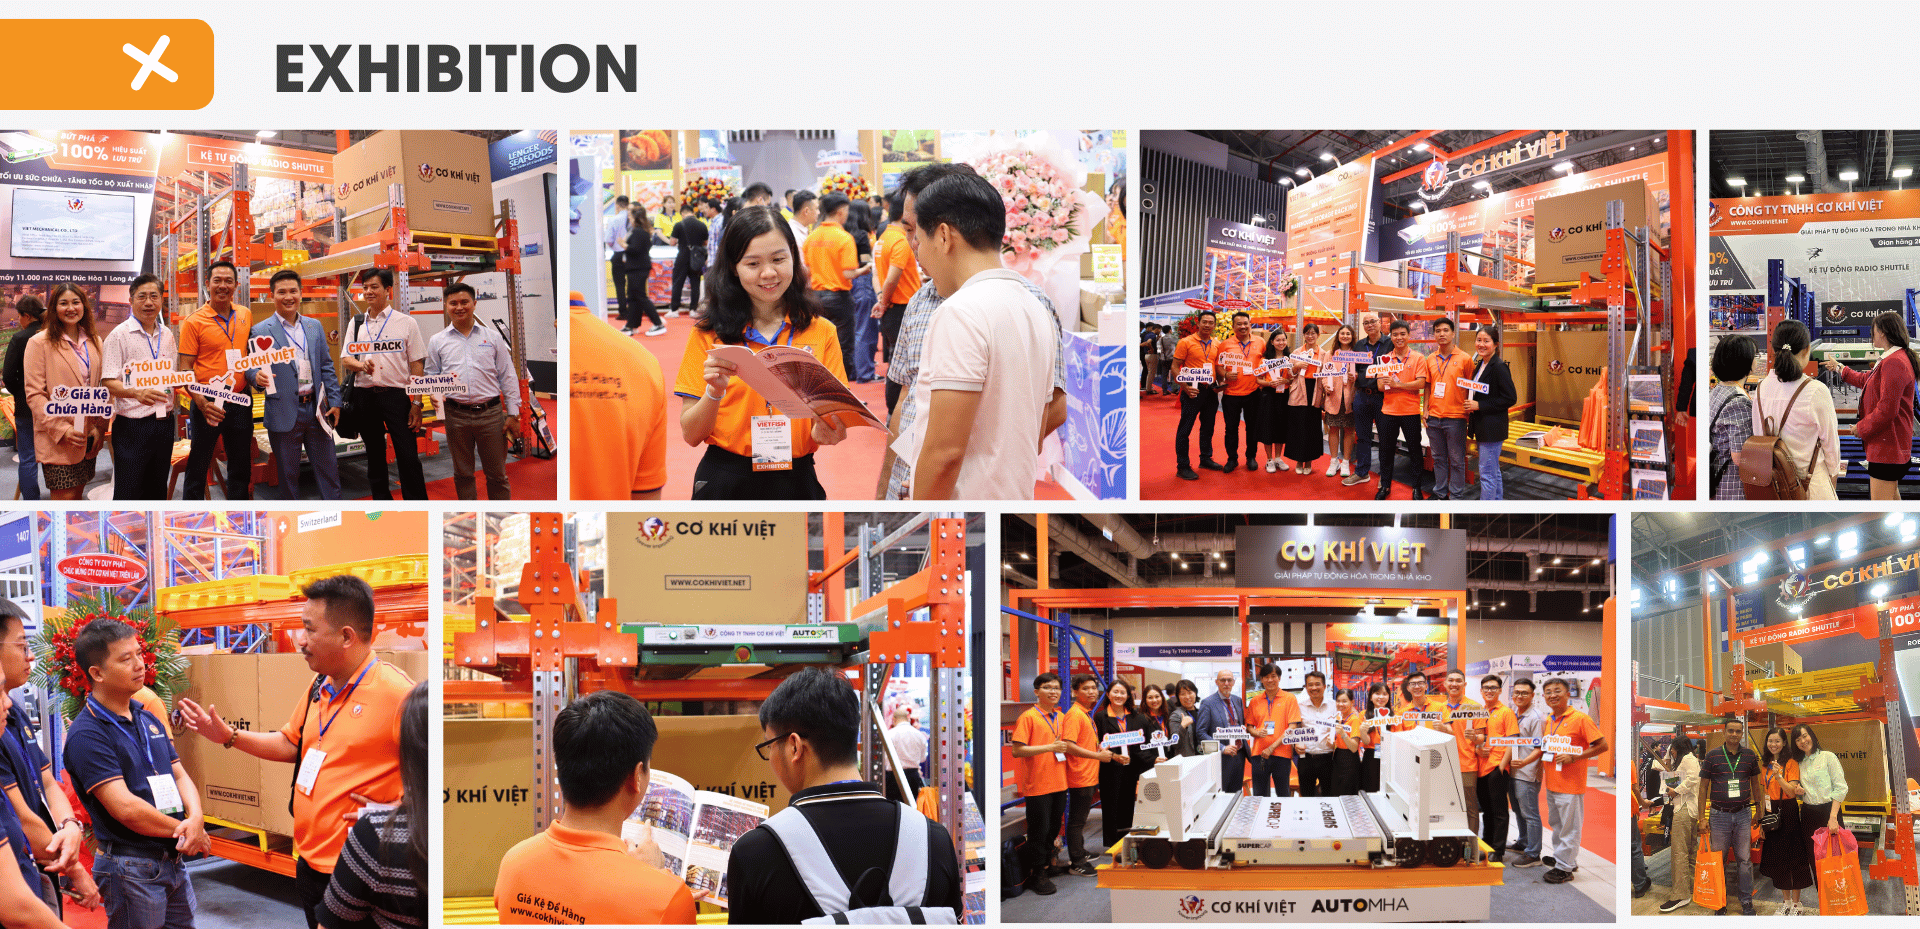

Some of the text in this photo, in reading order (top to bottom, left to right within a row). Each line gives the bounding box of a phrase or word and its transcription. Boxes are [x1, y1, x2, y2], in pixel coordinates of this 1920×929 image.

[61, 142, 109, 161] 100%
[508, 143, 539, 160] LENGER
[509, 146, 554, 168] SEAFOODS
[1458, 130, 1570, 181] CƠ KHÍ VIỆT
[200, 149, 325, 174] KỆ TỰ SHUTTLE
[25, 173, 135, 188] SỨC CHỨA TĂNG TỐC ĐỘ XUẤT
[352, 165, 397, 192] CƠ KHÍ VIỆT
[435, 167, 481, 185] CƠ KHÍ VIỆT
[1334, 202, 1358, 218] RACKING
[1729, 198, 1884, 217] CÔNG TY TNHH CƠ KHÍ VIỆT
[1431, 219, 1457, 234] 100%
[1568, 220, 1603, 236] CƠ KHÍ
[1730, 218, 1789, 227] WWW.COKHIVIET.NET
[1800, 223, 1911, 236] GIẢI PHÁP TỰ ĐỘNG HÓA TRONG NHÀ
[1221, 226, 1238, 239] CƠ
[1238, 229, 1255, 243] KHÍ
[1255, 232, 1277, 247] VIỆT
[1808, 263, 1910, 275] KỆ TỰ ĐỘNG RADIO SHUTTLE
[72, 273, 87, 282] Đức
[87, 274, 102, 282] Hòa
[110, 275, 126, 284] Long
[1850, 309, 1863, 319] CƠ
[348, 340, 402, 354] CKV RACK
[134, 360, 172, 373] TỐI ƯU
[234, 347, 295, 371] CƠ KHÍ VIỆT
[1236, 360, 1252, 368] HÀNG
[1190, 367, 1211, 377] Giá Kệ
[1254, 366, 1267, 376] CKV
[1268, 358, 1285, 371] RACK
[1367, 362, 1403, 375] CƠ KHÍ VIỆT
[1568, 364, 1601, 377] CƠ KHÍ
[136, 371, 193, 388] KHO HÀNG
[414, 375, 454, 385] Cơ Khí Việt
[1177, 374, 1213, 384] Chứa Hàng
[71, 387, 109, 402] Giá Kệ
[406, 384, 466, 396] Forever Improving
[46, 401, 112, 417] Chứa Hàng
[756, 462, 790, 471] EXHIBITOR
[300, 513, 338, 528] Switzerland
[16, 529, 30, 543] 1407
[676, 518, 777, 541] CƠ KHÍ VIỆT
[1281, 536, 1427, 570] CƠ KHÍ VIỆT
[78, 557, 93, 567] CÔNG
[94, 559, 101, 567] TY
[101, 560, 112, 568] DUY
[1274, 571, 1432, 582] GIẢI PHÁP TỰ ĐỘNG HÓA TRONG NHÀ KHO
[1823, 555, 1893, 591] CƠ KHÍ
[670, 579, 746, 587] WWW.COKHIVIET.NET
[756, 629, 765, 637] CƠ
[775, 630, 785, 638] VIỆT
[1749, 620, 1840, 646] KỆ TỰ ĐỘNG RADIO SHUTTLE
[1159, 648, 1172, 656] Công
[1451, 710, 1490, 719] AUTOMHA
[1294, 727, 1315, 736] Giá Kệ
[1283, 734, 1319, 745] Chứa Hàng
[1548, 744, 1581, 754] KHO HÀNG
[1850, 750, 1867, 761] VIỆT
[209, 788, 256, 803] WWW.COKHIVIET.NET
[456, 784, 528, 807] KHÍ VIỆT
[741, 780, 777, 802] VIỆT
[1237, 842, 1272, 850] SUPERCAP
[516, 892, 586, 925] Giá Kệ Đế Hàng
[1211, 897, 1410, 917] CƠ KHÍ VIỆT AUTOMHA
